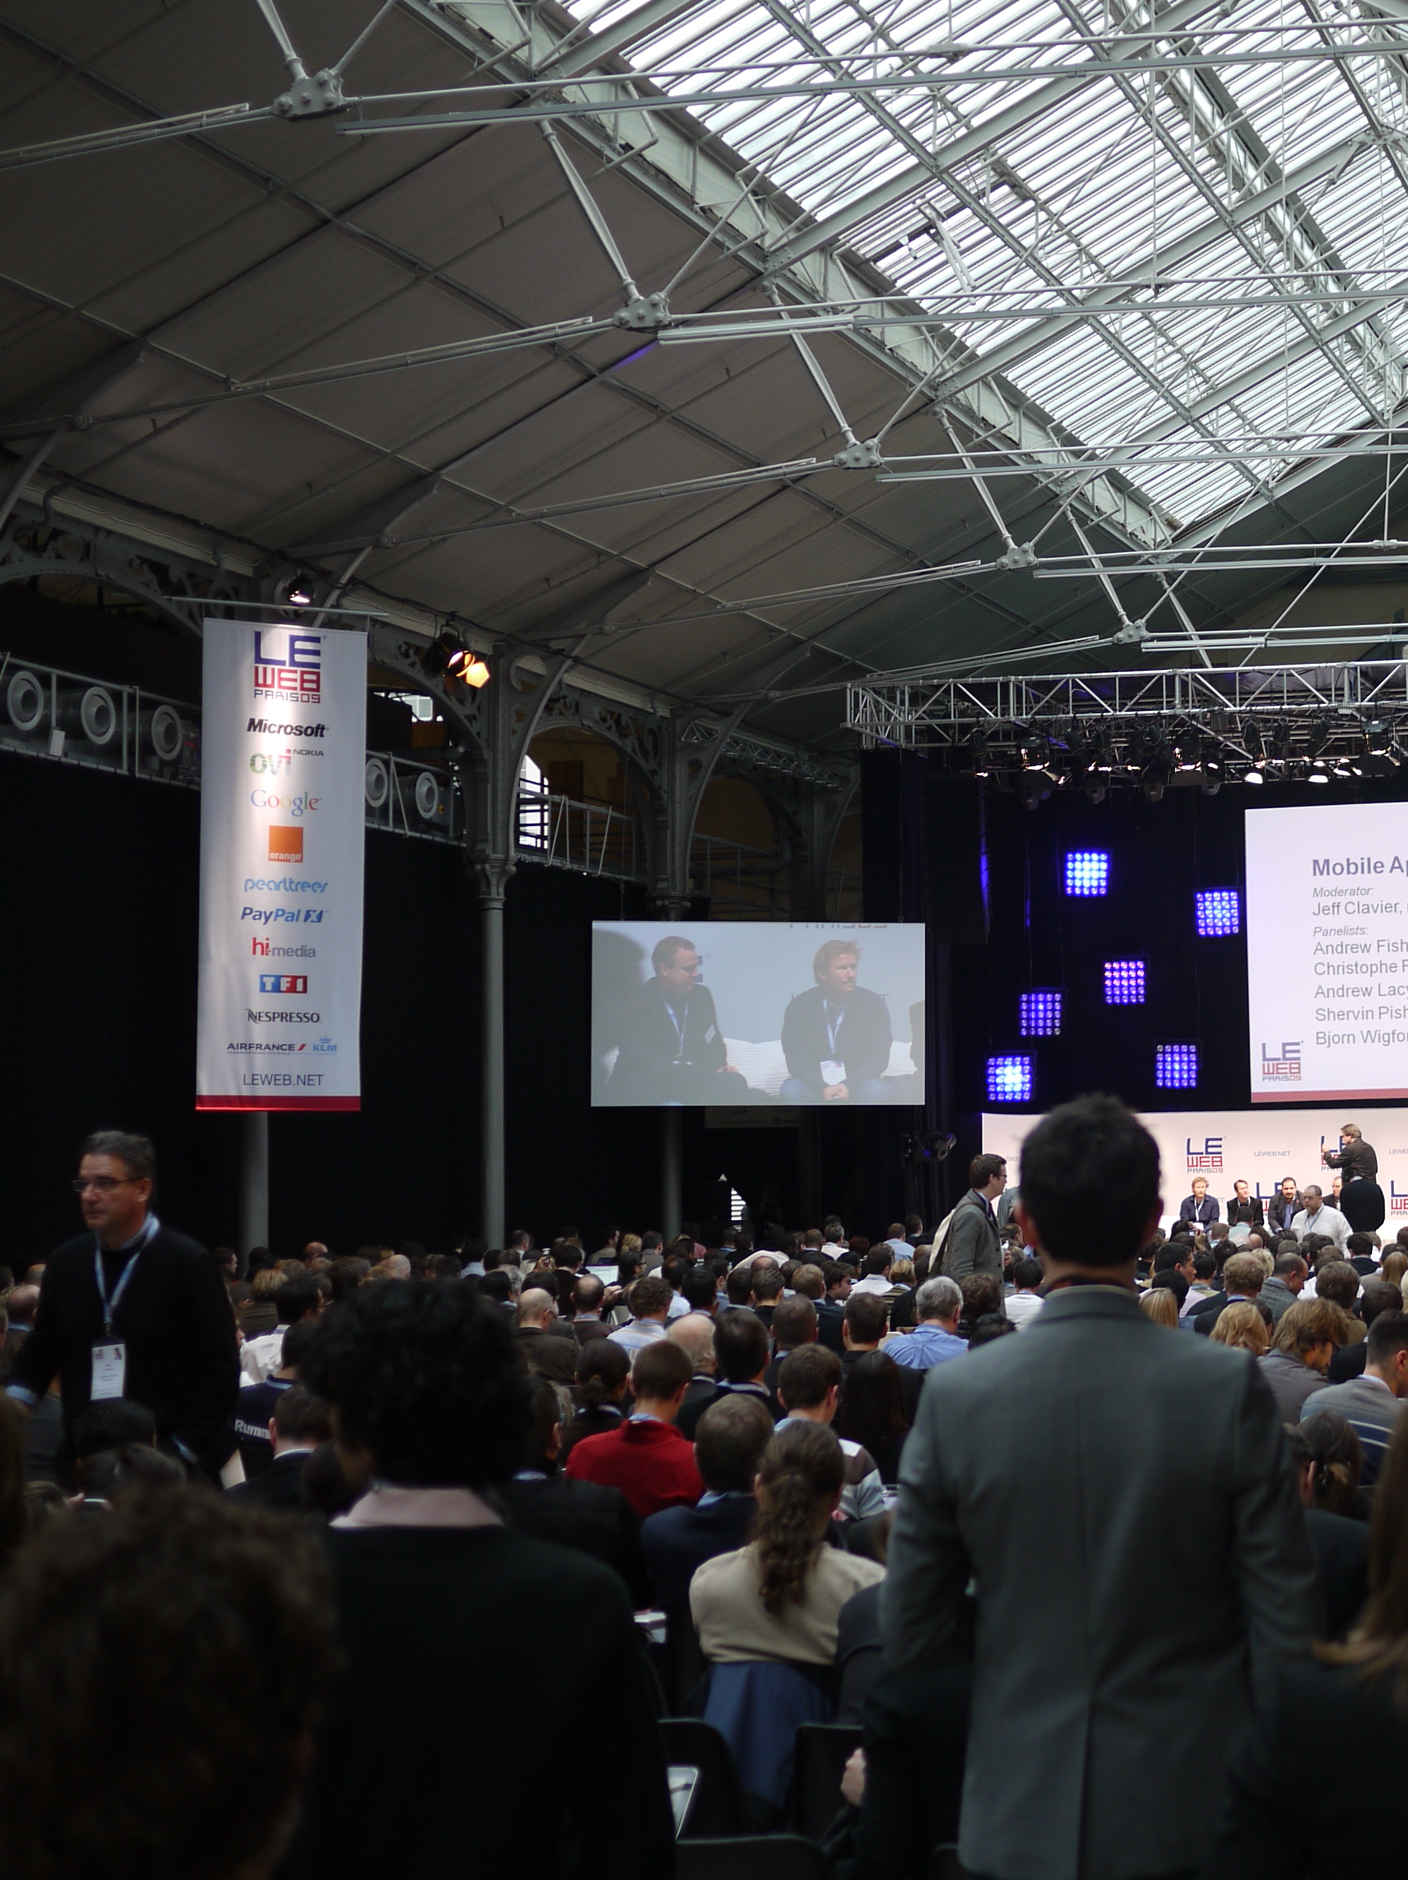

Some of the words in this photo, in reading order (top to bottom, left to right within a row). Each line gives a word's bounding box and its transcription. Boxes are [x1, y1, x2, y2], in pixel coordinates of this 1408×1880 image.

[254, 631, 321, 669] LE
[254, 666, 321, 692] WEB
[254, 689, 321, 704] PARIS09
[247, 718, 325, 738] Microsoft
[251, 789, 319, 817] Google
[269, 852, 301, 862] orange
[1312, 857, 1385, 877] Mobile
[244, 877, 328, 892] pearltrees
[1312, 887, 1374, 898] Moderator:
[1312, 902, 1341, 916] Jeff
[1344, 900, 1403, 915] Clavier,
[241, 907, 300, 925] PayPal
[1313, 925, 1369, 937] Panelists:
[1313, 941, 1372, 955] Andrew
[1314, 960, 1398, 977] Christophe
[262, 977, 304, 991] TF1
[1314, 984, 1373, 999] Andrew
[245, 1009, 320, 1023] NESPRESSO
[1315, 1007, 1374, 1021] Shervin
[1315, 1031, 1356, 1048] Bjorn
[313, 1044, 337, 1052] KLM
[1262, 1042, 1301, 1062] LE
[1262, 1062, 1301, 1075] WEB
[243, 1074, 324, 1086] LEWEB.NET
[1186, 1137, 1222, 1155] LE
[1187, 1156, 1222, 1167] WEB
